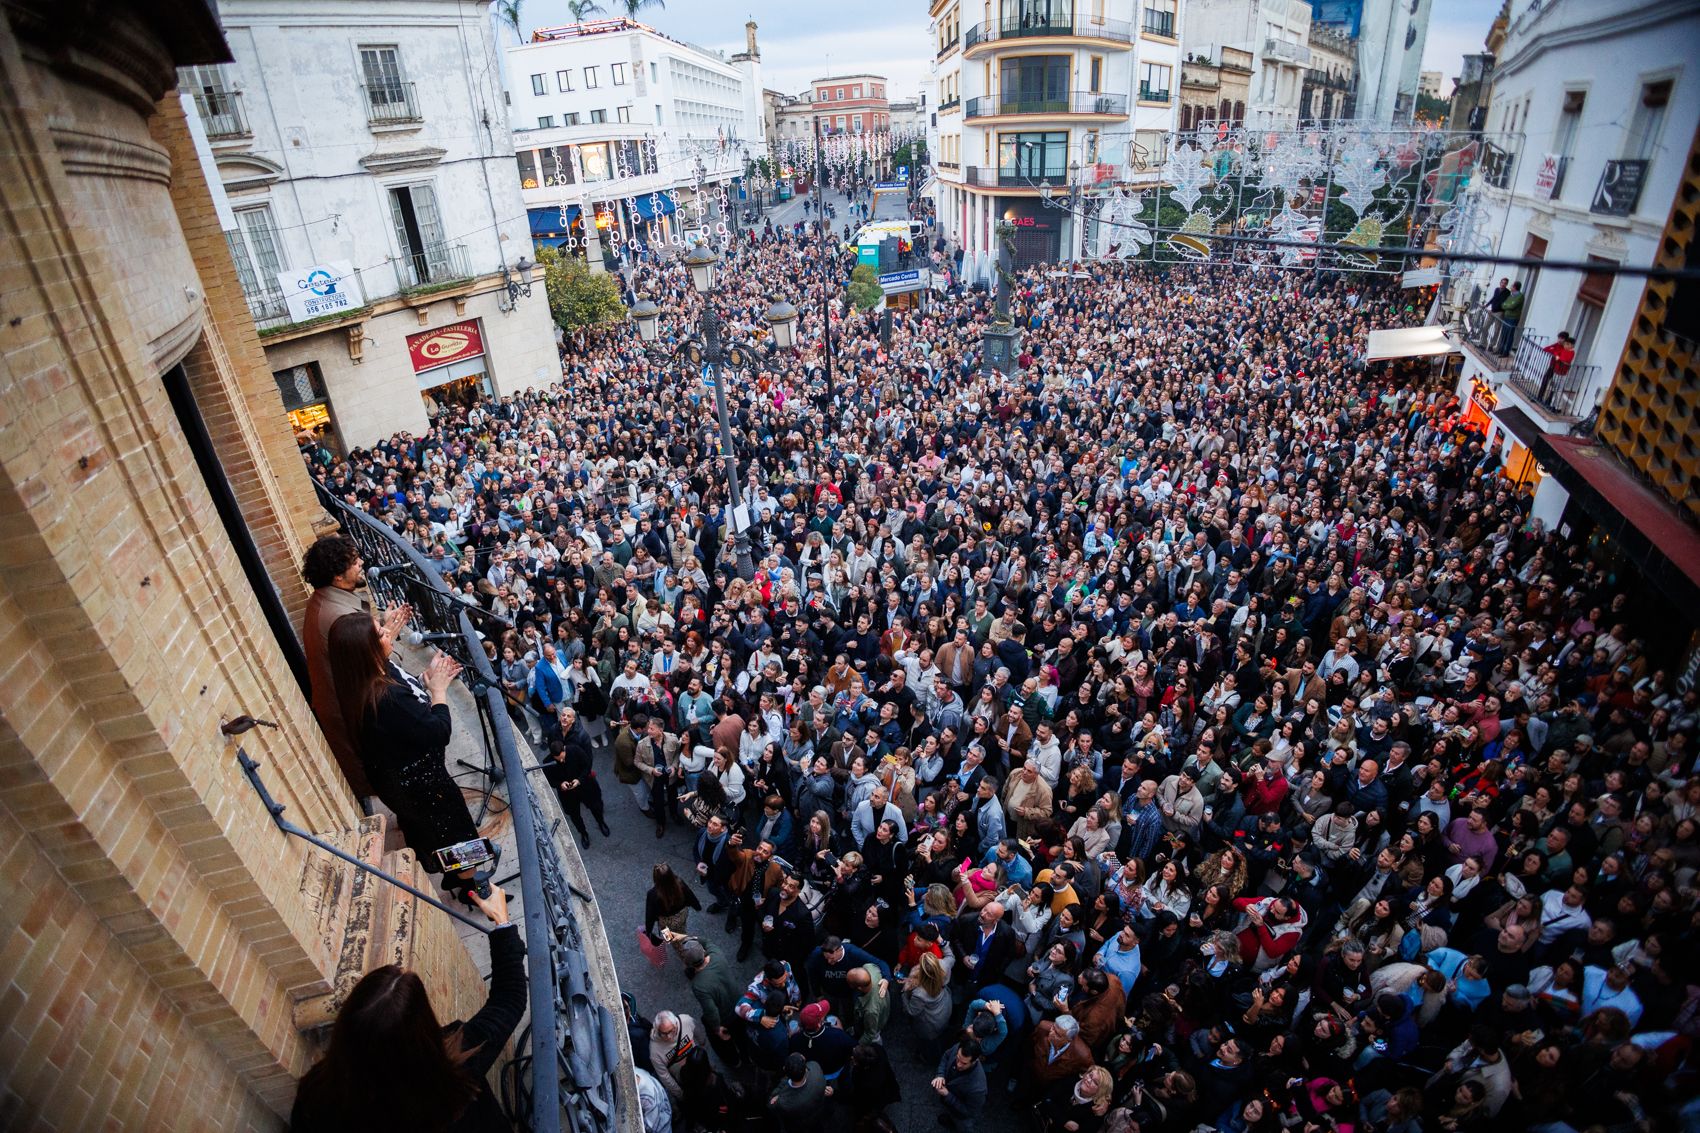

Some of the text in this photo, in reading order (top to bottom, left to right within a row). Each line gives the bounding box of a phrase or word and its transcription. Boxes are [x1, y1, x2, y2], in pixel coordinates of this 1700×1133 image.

[900, 166, 906, 174] P
[1011, 217, 1034, 226] GAES
[304, 292, 346, 306] CONSTRUCTORA
